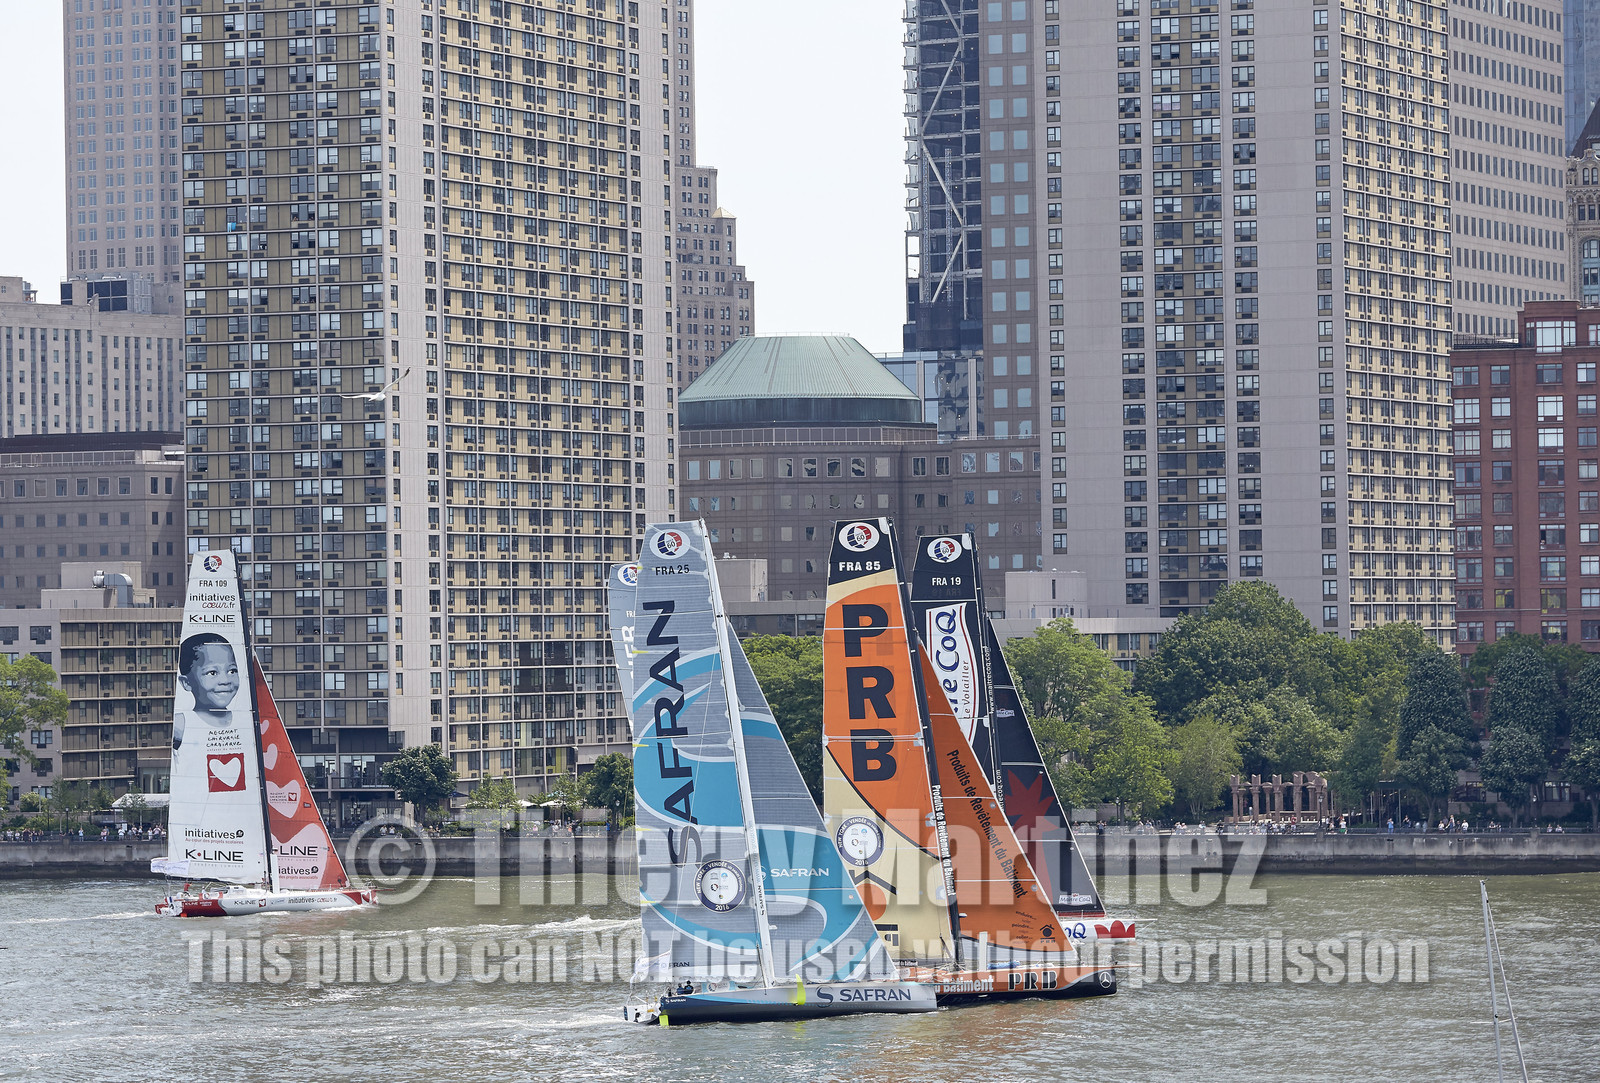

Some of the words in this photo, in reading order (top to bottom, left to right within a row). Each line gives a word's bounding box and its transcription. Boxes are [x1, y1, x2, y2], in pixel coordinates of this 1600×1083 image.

[655, 566, 675, 575] FRA
[677, 564, 690, 573] 25
[838, 561, 862, 571] FRA
[865, 560, 881, 571] 85
[931, 577, 948, 586] FRA
[950, 576, 962, 586] 19
[189, 593, 236, 602] initiatives
[961, 660, 971, 702] Volailler
[642, 599, 702, 868] SAFRAN
[932, 785, 944, 811] Produits
[937, 812, 945, 820] de
[947, 750, 971, 786] Produits
[964, 786, 976, 798] de
[970, 798, 1001, 847] Revêtement
[994, 843, 1008, 862] du
[1001, 857, 1028, 899] Bâtiment
[185, 828, 235, 839] initiatives
[279, 866, 311, 875] iatives
[771, 868, 829, 877] SAFRAN
[944, 867, 956, 896] Bâtiment
[1064, 922, 1087, 939] oQ
[943, 974, 994, 993] Bâtiment
[1008, 971, 1058, 991] PRB
[839, 988, 912, 1002] SAFRAN
